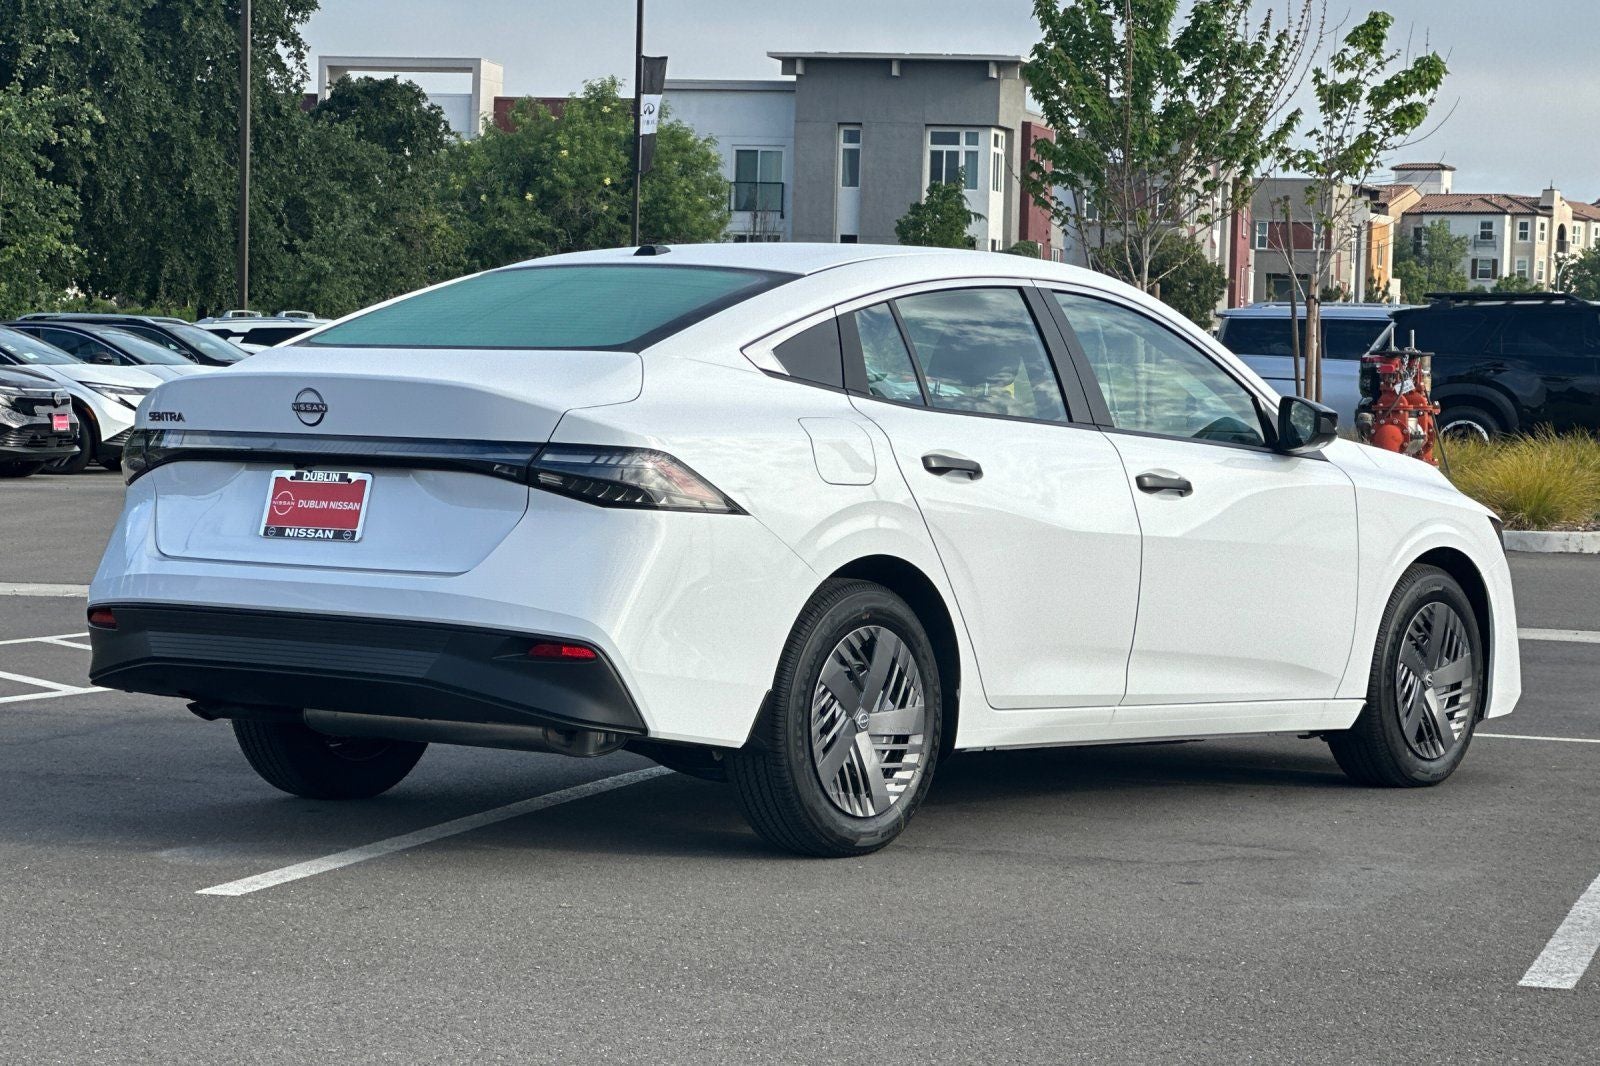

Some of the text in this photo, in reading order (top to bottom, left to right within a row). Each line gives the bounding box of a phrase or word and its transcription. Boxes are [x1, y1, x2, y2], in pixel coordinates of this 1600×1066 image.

[292, 403, 327, 412] NISSAN
[148, 411, 185, 422] SENTRA
[302, 472, 340, 482] DUBLIN
[297, 499, 361, 511] DUBLIN NISSAN
[284, 527, 335, 539] NISSAN
